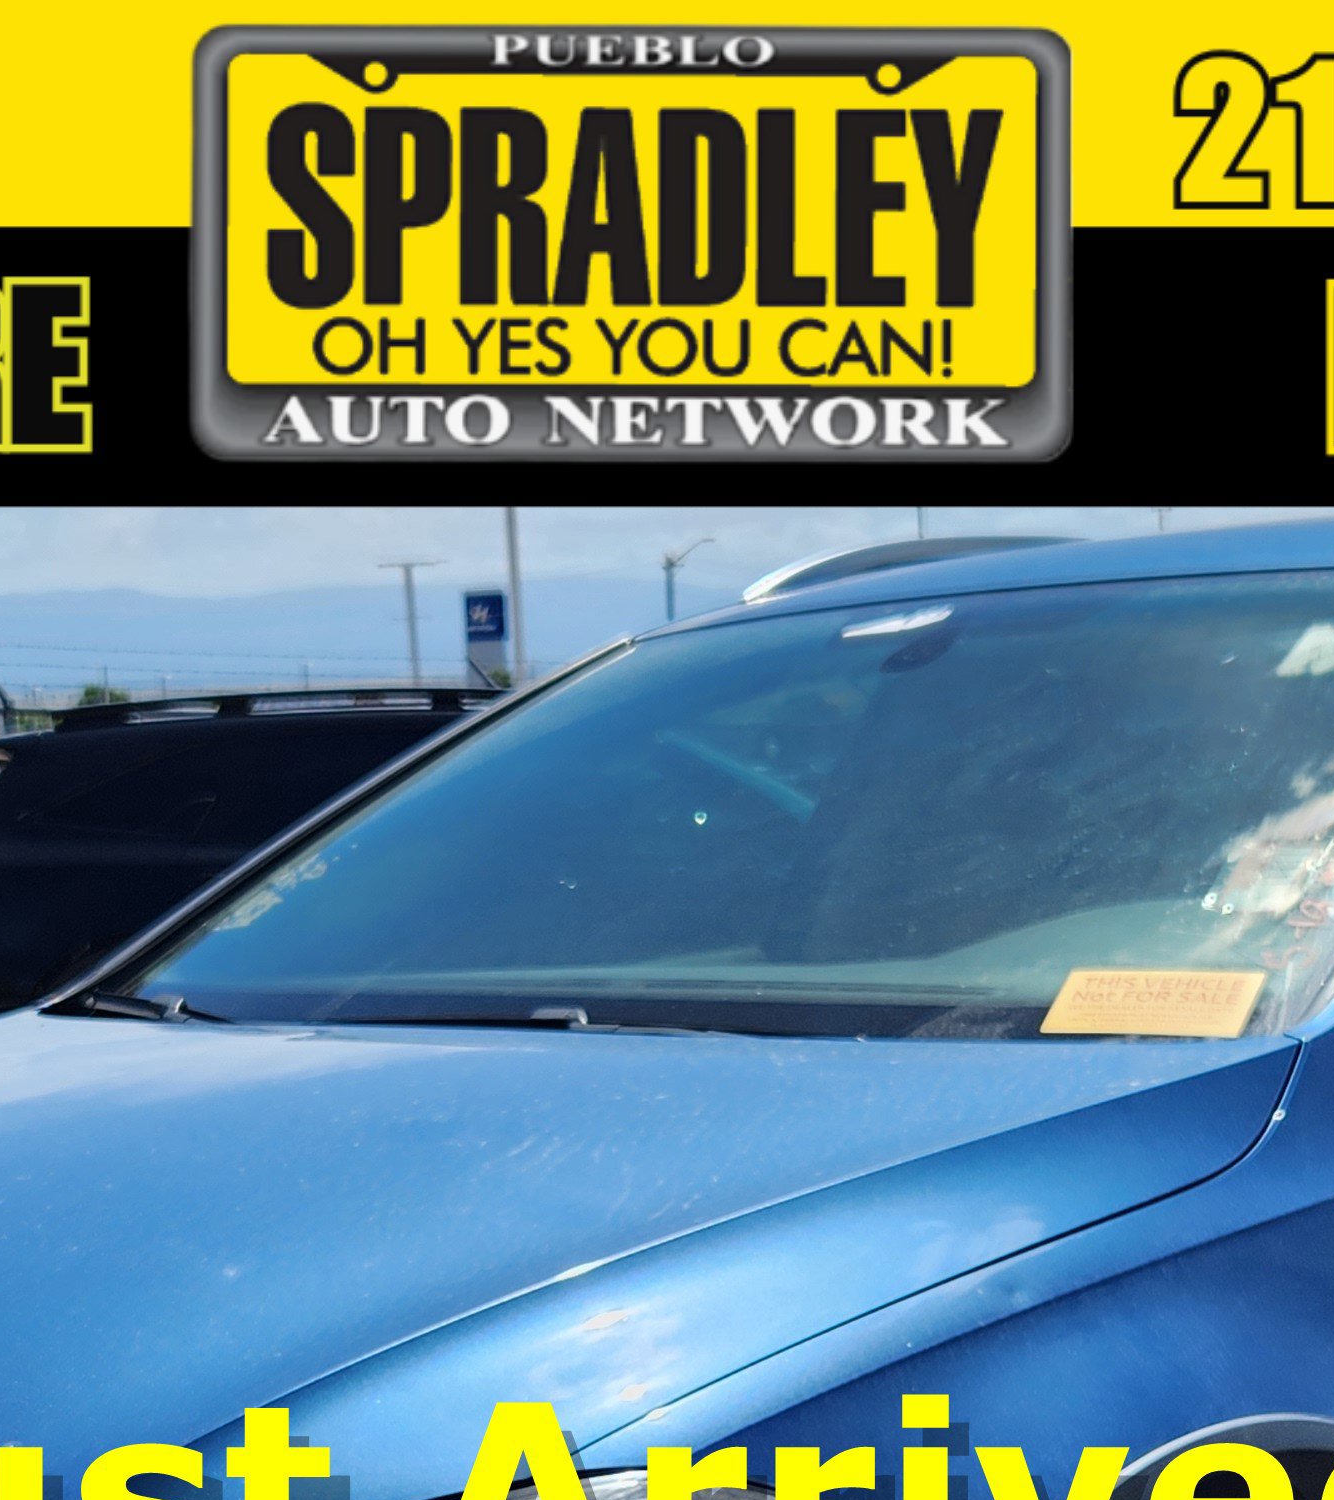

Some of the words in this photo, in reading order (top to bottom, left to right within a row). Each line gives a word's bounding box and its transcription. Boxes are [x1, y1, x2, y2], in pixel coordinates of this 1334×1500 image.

[1084, 977, 1137, 990] THIS
[1144, 977, 1247, 992] VEHICLE
[1121, 991, 1171, 1003] FOR
[1176, 991, 1242, 1006] SALE
